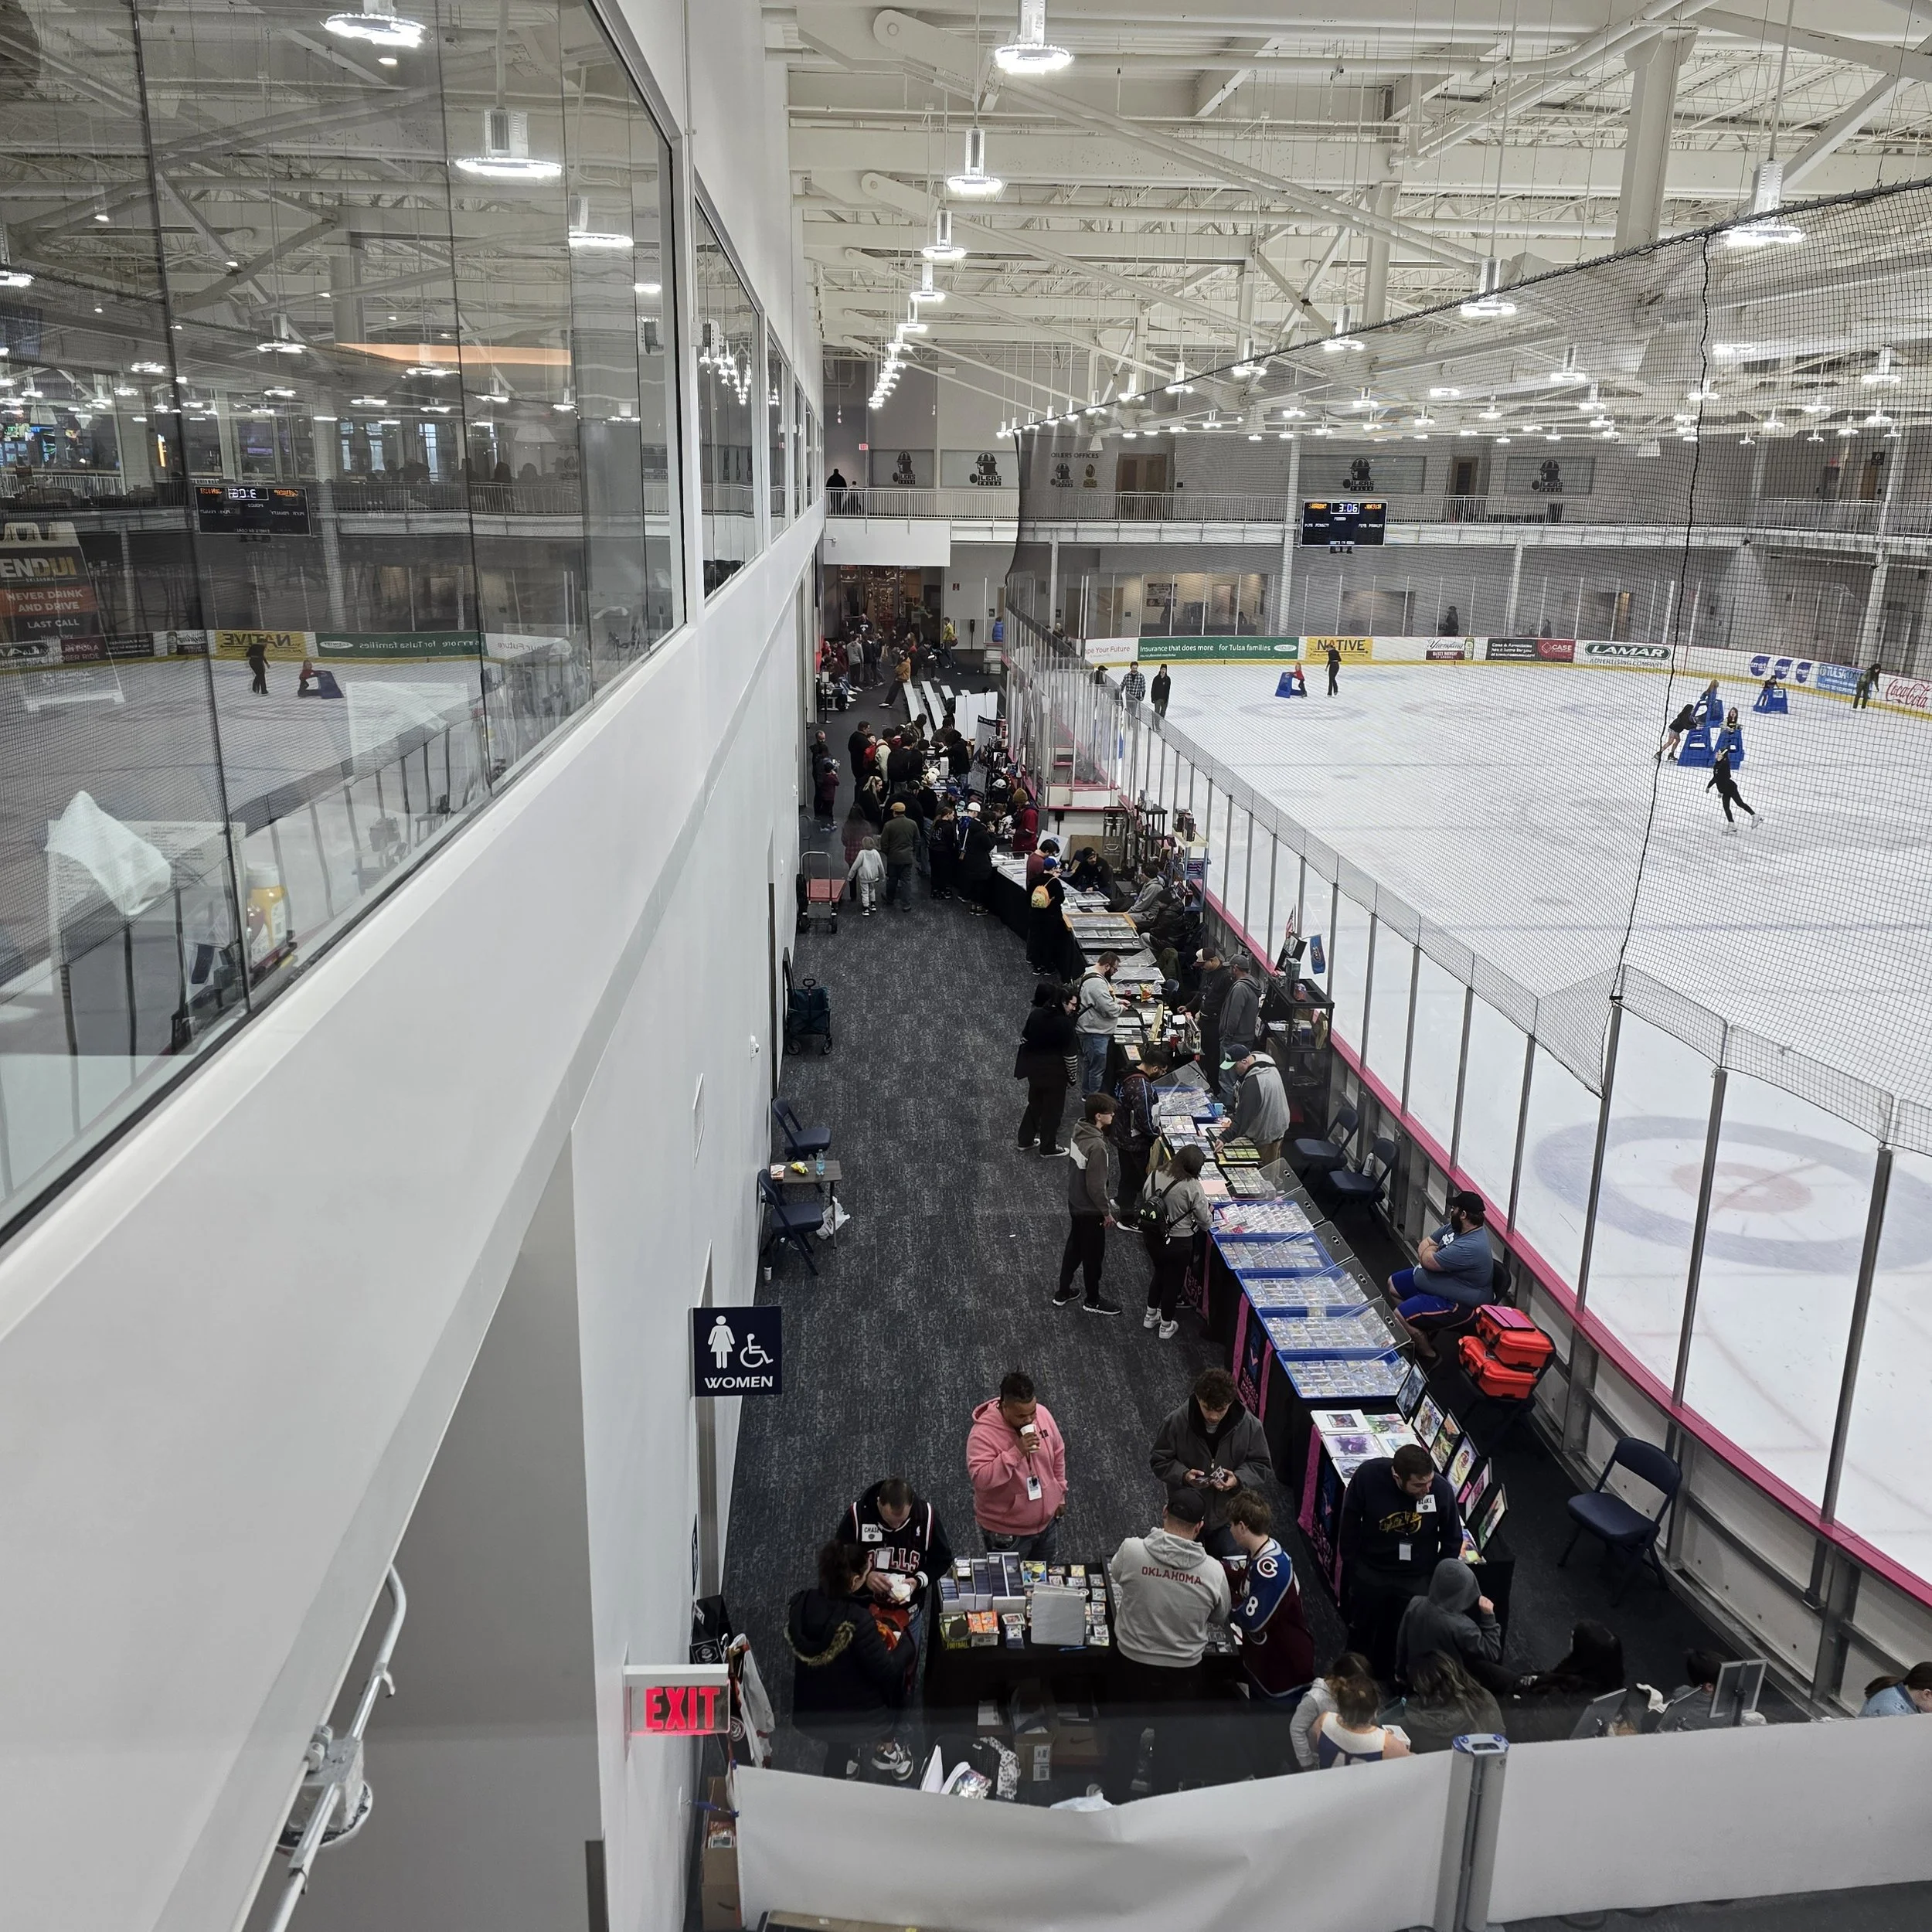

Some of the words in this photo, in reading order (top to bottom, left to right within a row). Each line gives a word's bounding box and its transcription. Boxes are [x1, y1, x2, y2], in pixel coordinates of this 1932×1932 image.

[1338, 503, 1359, 512] 3:06
[7, 590, 45, 602] NEVER
[47, 589, 83, 599] DRINK
[19, 603, 43, 613] AND
[46, 601, 80, 611] DRIVE
[27, 620, 52, 628] LAST
[55, 618, 80, 628] CALL
[1317, 639, 1366, 651] NATIVE
[1592, 645, 1665, 657] LAMAR
[704, 1376, 774, 1389] WOMEN
[1141, 1566, 1202, 1587] OKLAHOMA
[1246, 1596, 1259, 1617] 8
[645, 1685, 721, 1731] EXIT
